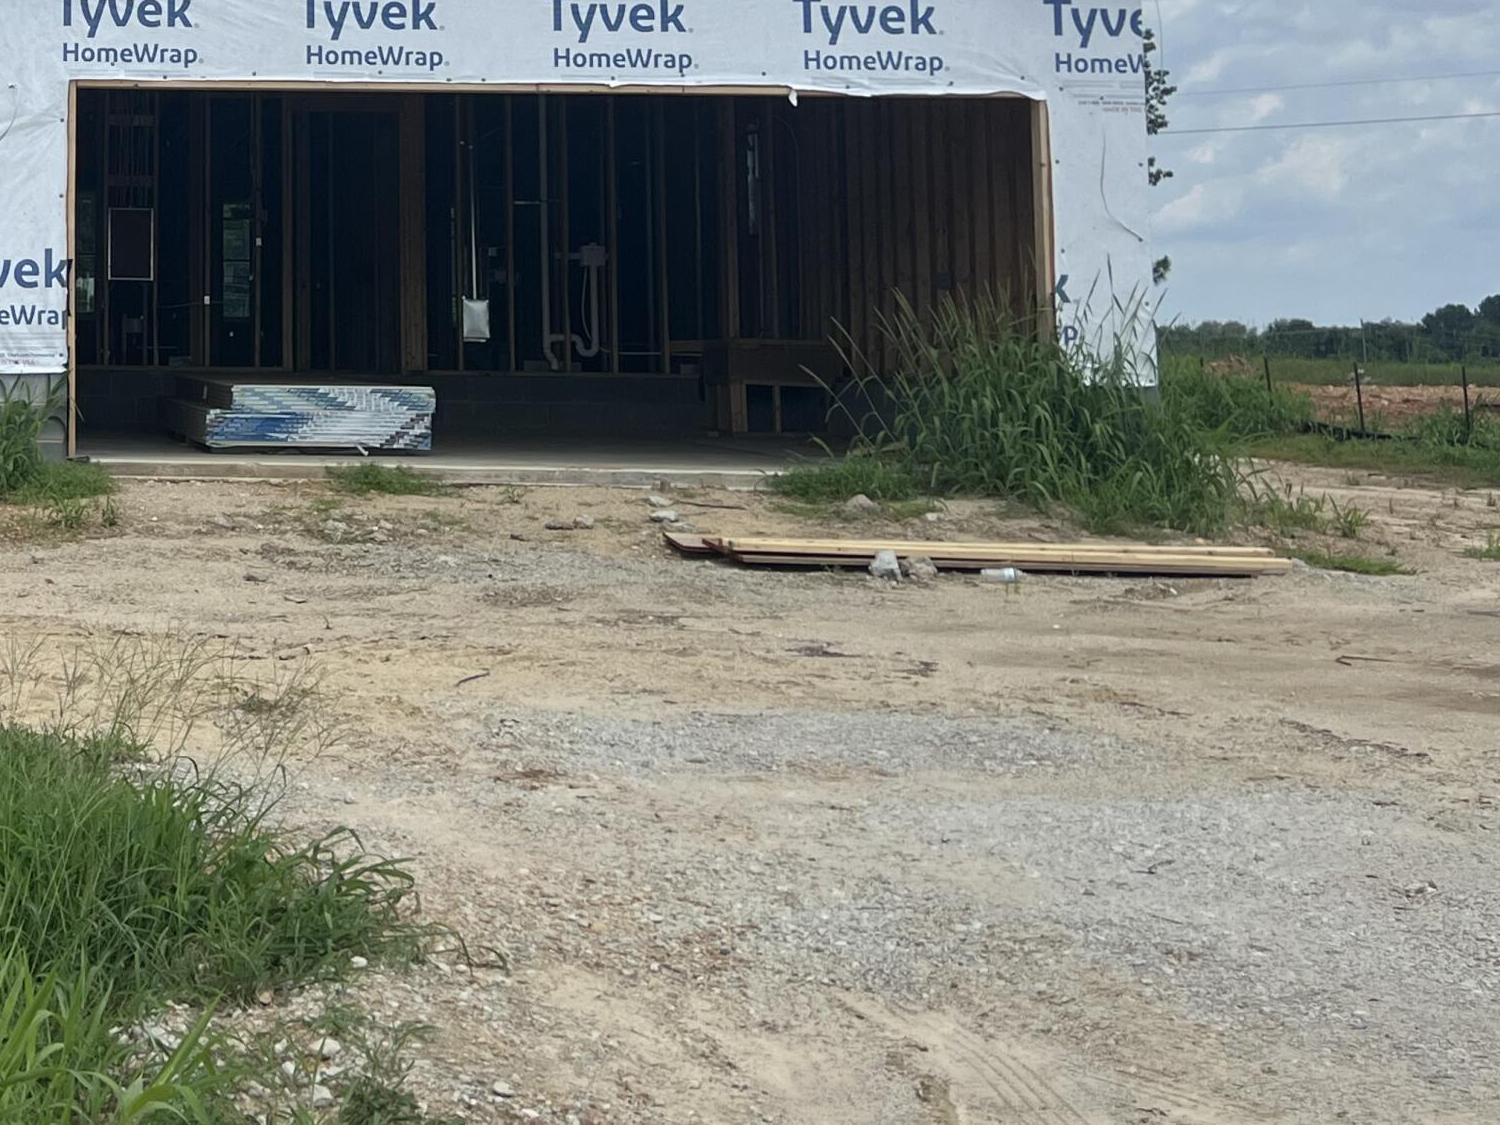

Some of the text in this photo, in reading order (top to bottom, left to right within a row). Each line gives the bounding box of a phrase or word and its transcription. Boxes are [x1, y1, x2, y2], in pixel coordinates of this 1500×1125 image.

[62, 43, 198, 68] HomeWrap
[306, 45, 443, 70] HomeWrap
[553, 47, 693, 72] HomeWrap
[803, 49, 943, 74] HomeWrap
[1055, 53, 1145, 74] HomeW
